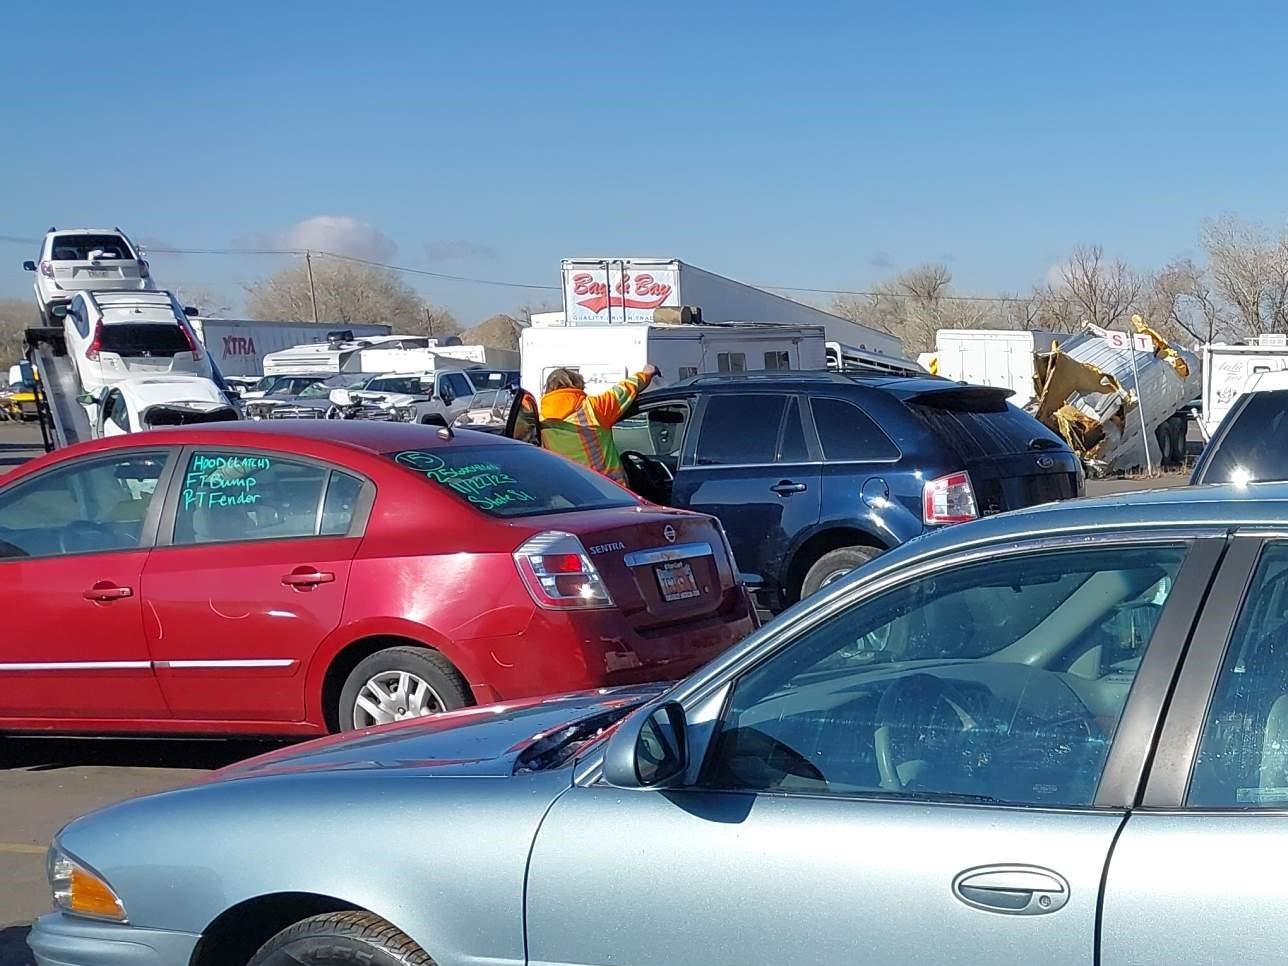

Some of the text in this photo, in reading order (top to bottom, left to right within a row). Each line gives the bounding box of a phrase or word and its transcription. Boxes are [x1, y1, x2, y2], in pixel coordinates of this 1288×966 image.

[634, 273, 672, 303] Bay
[222, 335, 257, 360] XTRA
[1112, 334, 1124, 346] S
[1136, 336, 1149, 349] T
[209, 473, 257, 492] Bump
[589, 541, 625, 555] SENTRA
